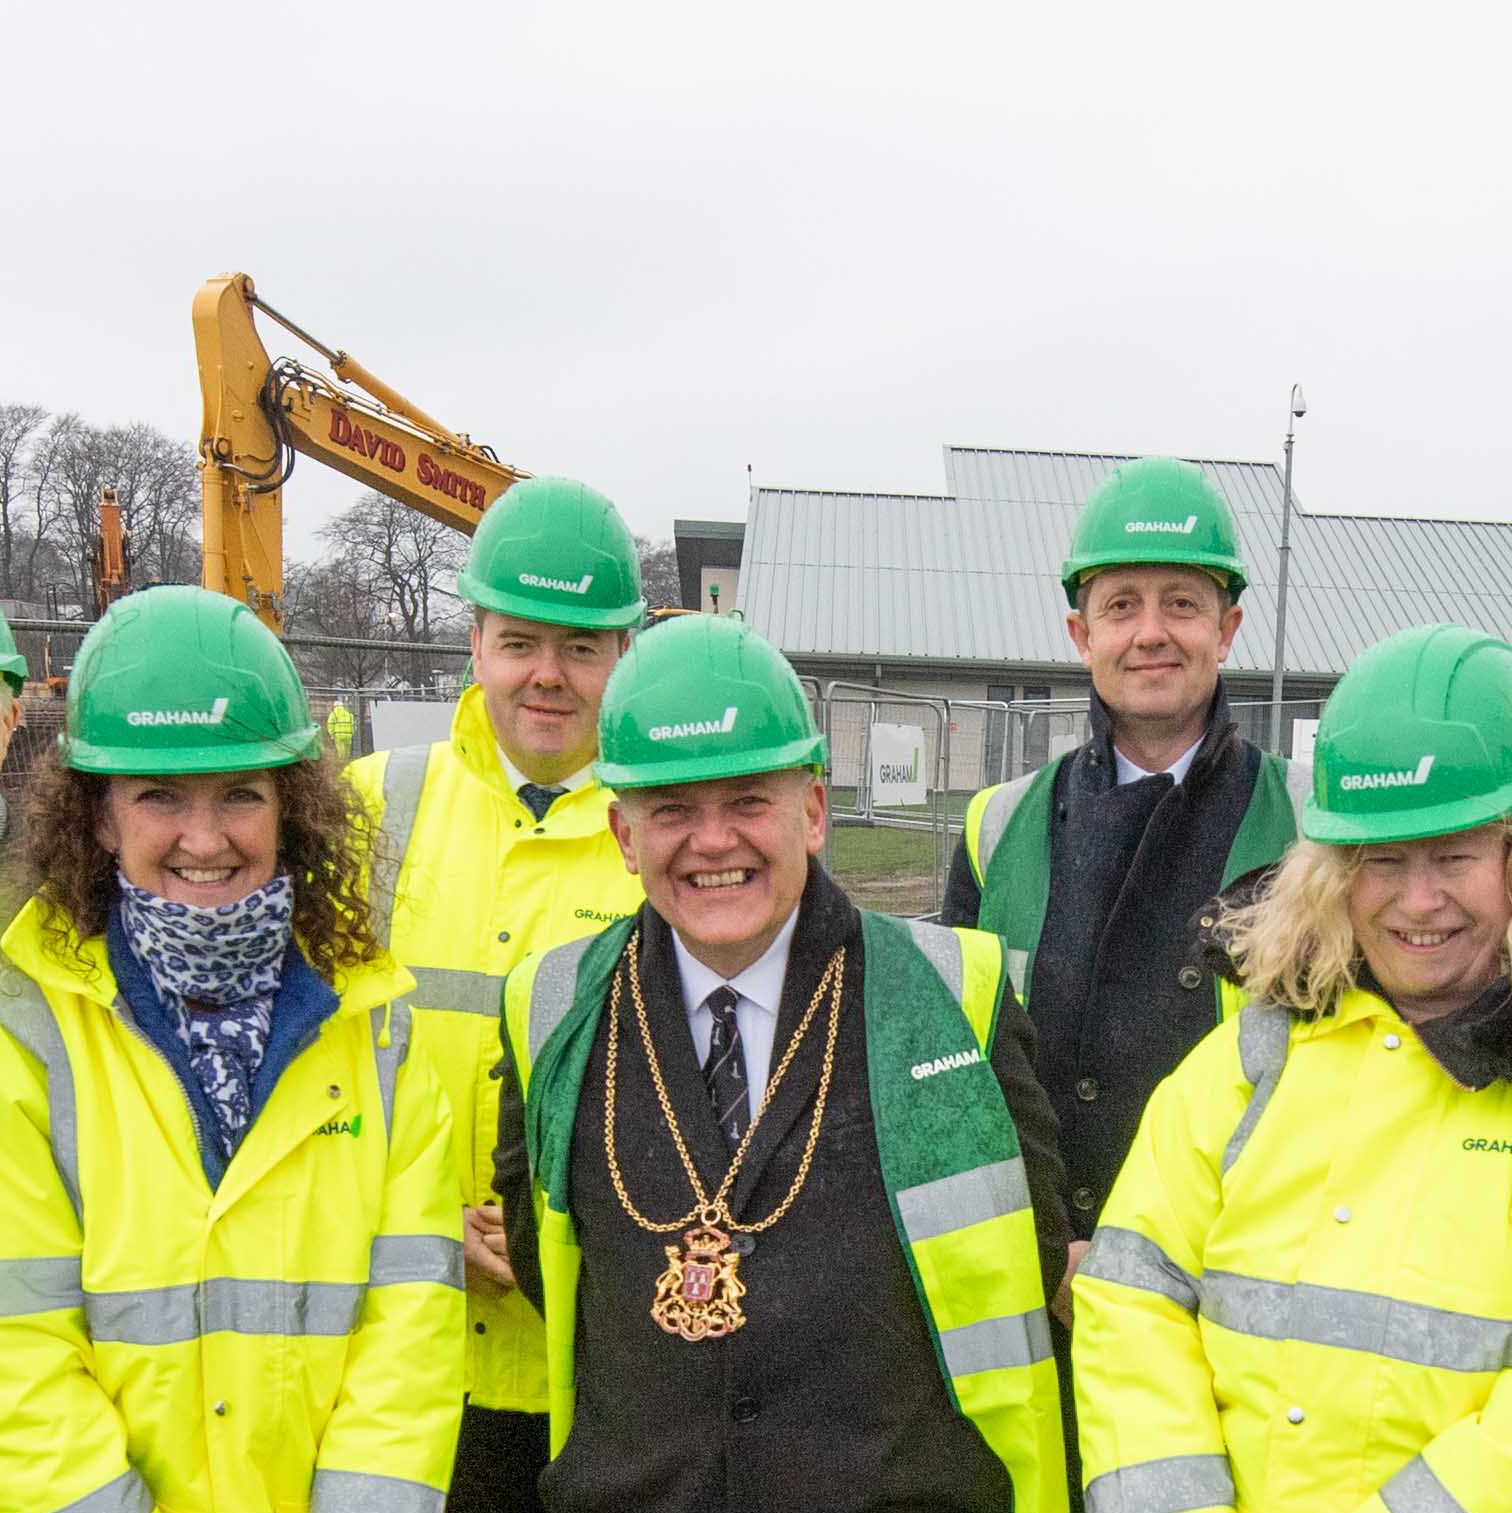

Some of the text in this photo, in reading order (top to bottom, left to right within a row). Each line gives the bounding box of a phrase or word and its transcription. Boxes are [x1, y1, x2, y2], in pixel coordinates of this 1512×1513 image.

[328, 408, 486, 511] DAVID SMITH
[1125, 521, 1185, 534] GRAHAM
[519, 574, 579, 593] GRAHAM
[127, 712, 211, 726] GRAHAM
[649, 720, 722, 741] GRAHAM
[879, 764, 913, 784] GRAHAM
[1341, 771, 1415, 790] GRAHAM
[911, 1047, 981, 1081] GRAHAM
